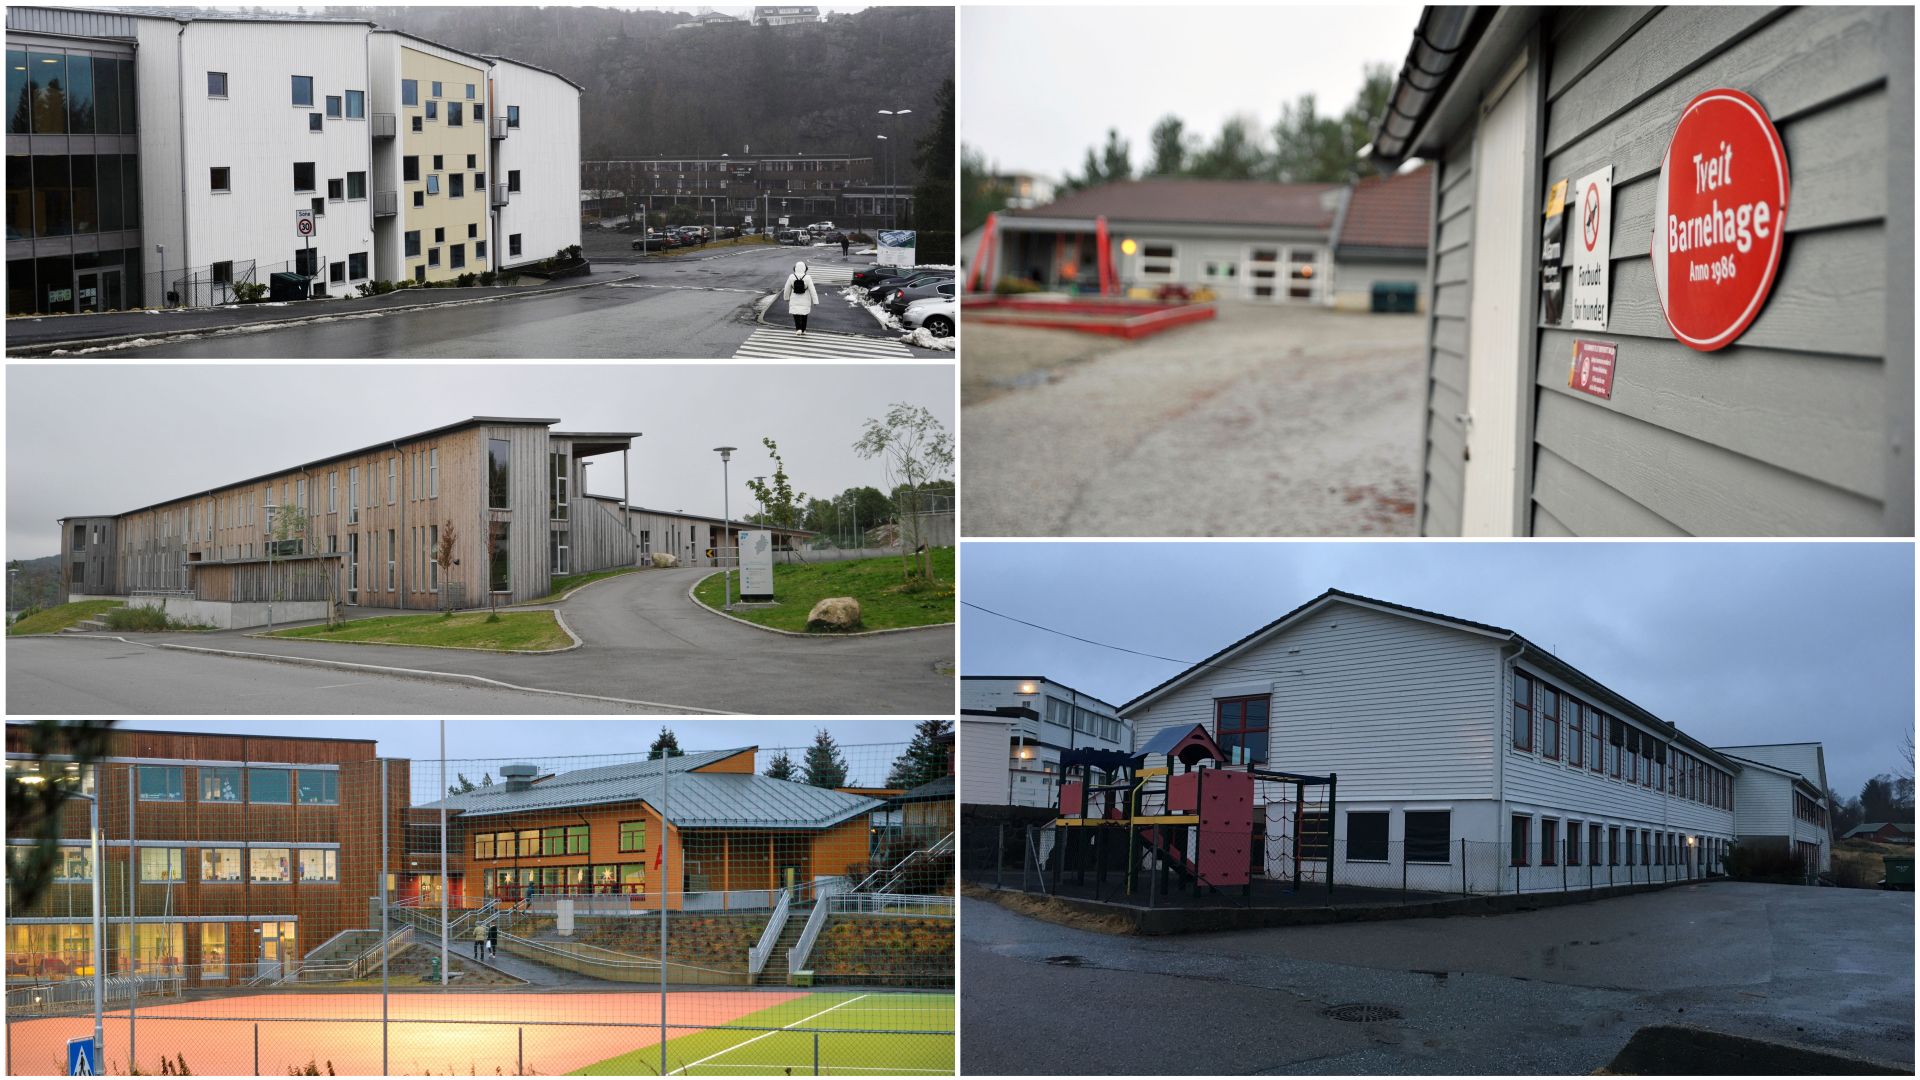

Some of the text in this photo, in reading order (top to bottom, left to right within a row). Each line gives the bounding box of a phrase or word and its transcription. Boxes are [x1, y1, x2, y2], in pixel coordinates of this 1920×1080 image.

[1693, 140, 1733, 195] Tveit
[301, 222, 310, 230] 30
[1669, 198, 1771, 254] Barnehage
[1578, 261, 1601, 287] Forbudt
[1689, 253, 1736, 285] Anno 1986
[1583, 297, 1605, 322] hunder
